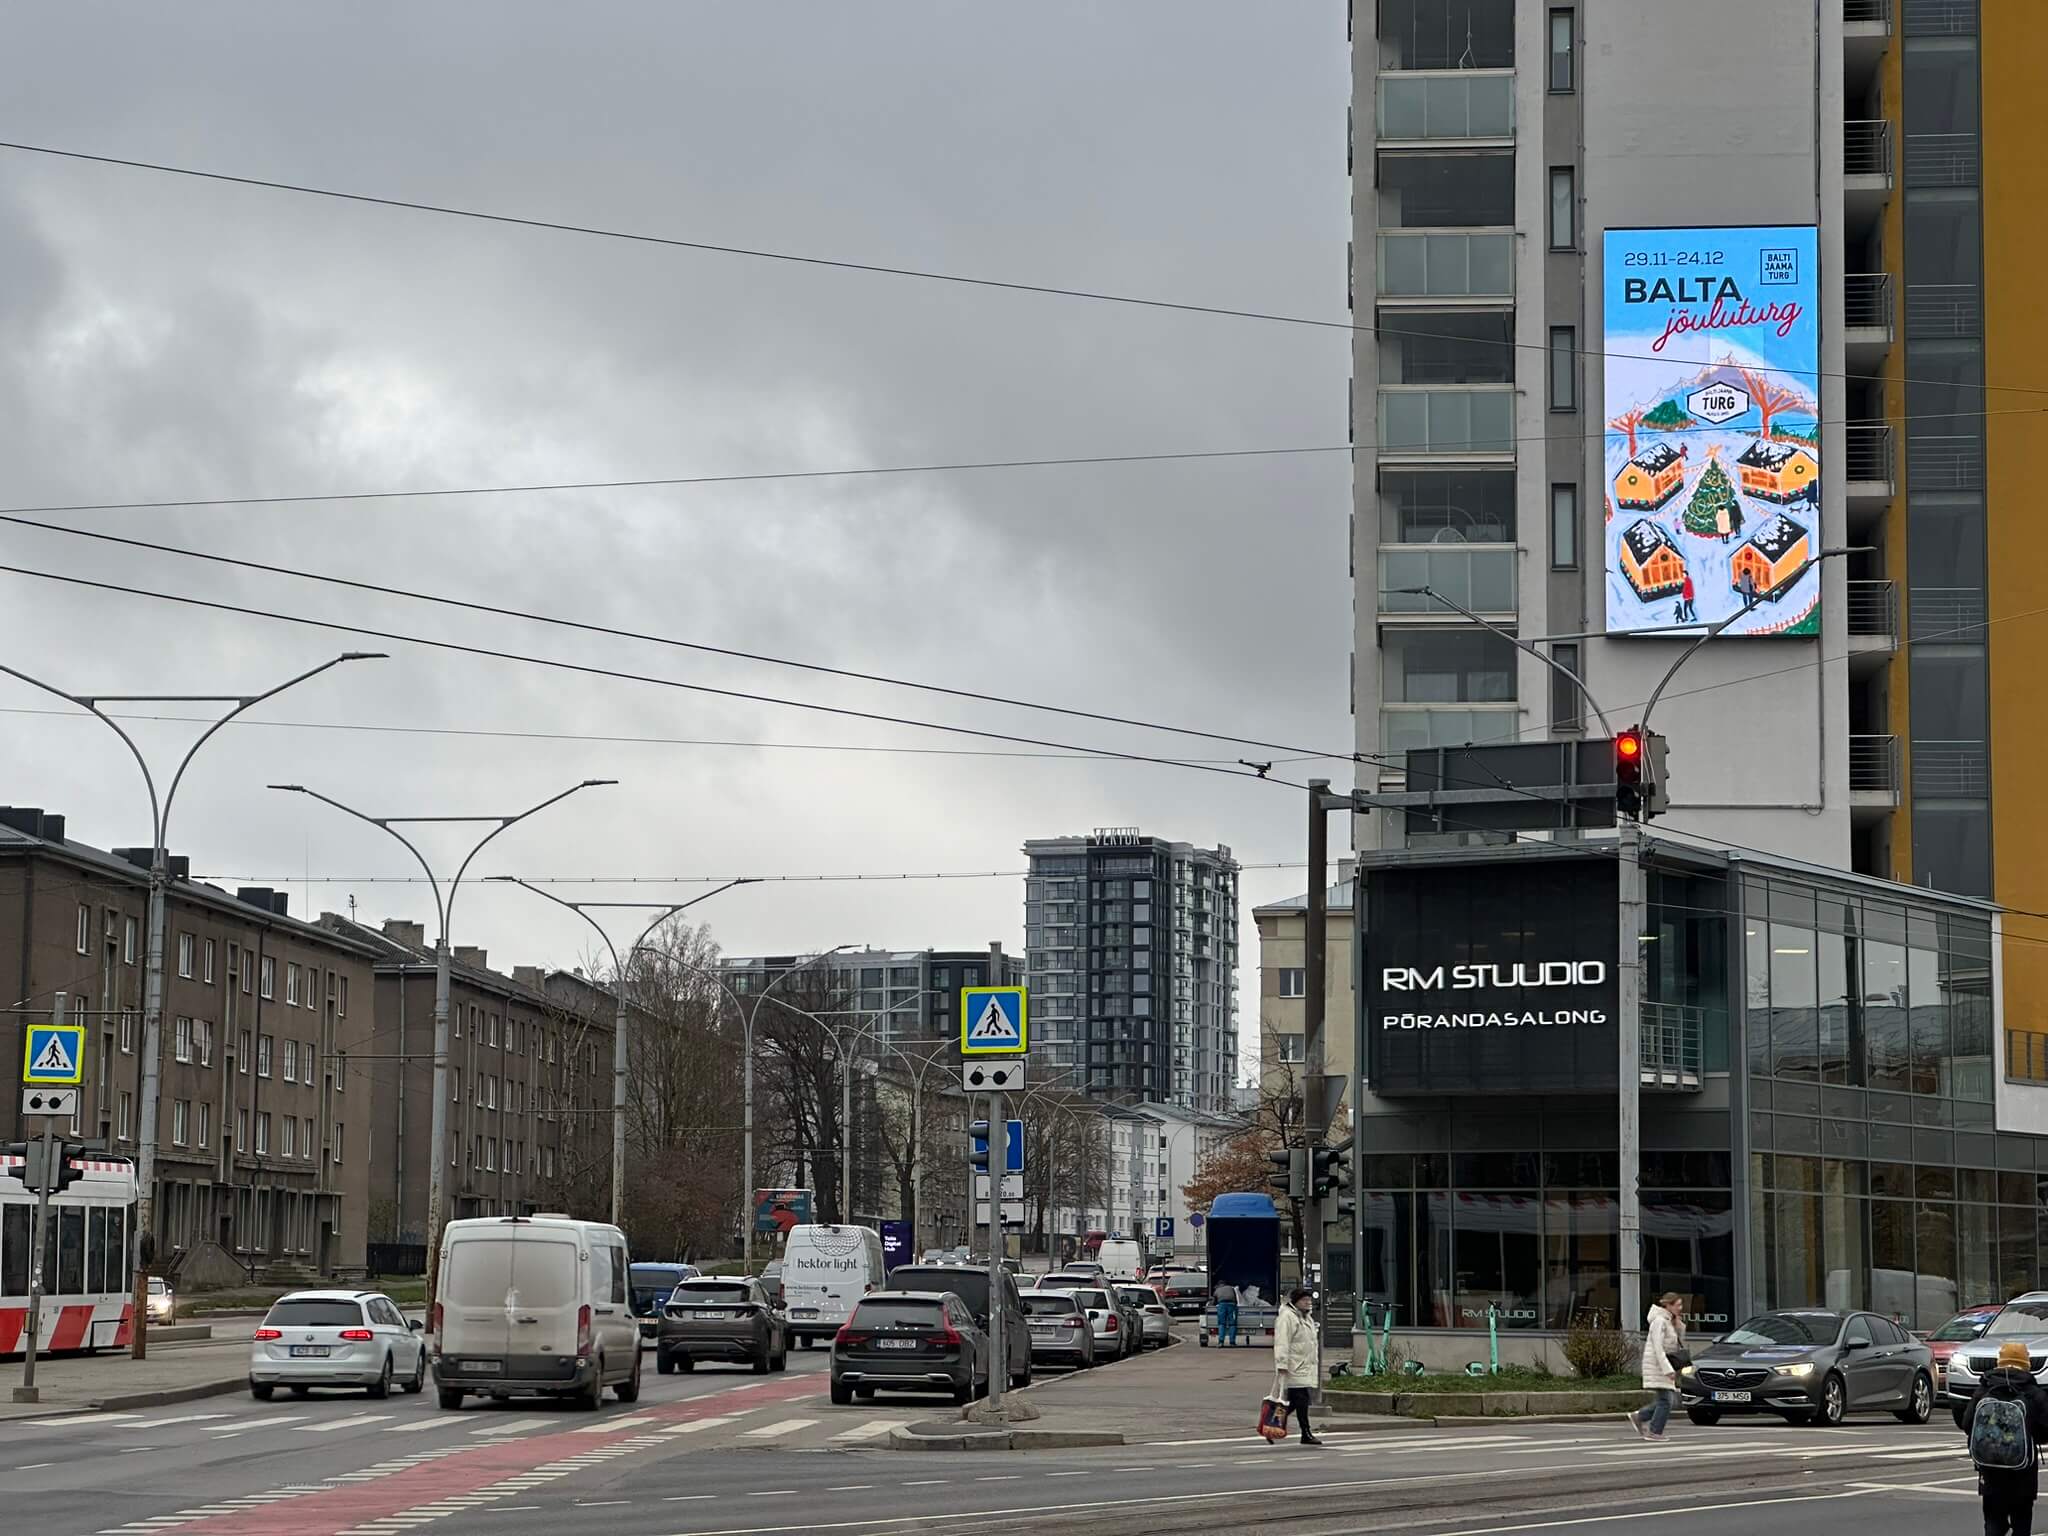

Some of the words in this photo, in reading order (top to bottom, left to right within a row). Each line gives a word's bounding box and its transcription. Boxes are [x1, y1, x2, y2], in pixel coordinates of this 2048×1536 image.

[1624, 250, 1724, 266] 29.11-24.12
[1767, 253, 1791, 262] BALTI
[1765, 262, 1793, 271] JAAMA
[1768, 271, 1790, 280] TURG
[1624, 276, 1743, 304] BALTA
[1652, 297, 1803, 353] jõuluturg
[1702, 396, 1735, 410] TURG
[1383, 966, 1446, 991] RM
[1452, 961, 1606, 989] STUUDIO
[1383, 1009, 1607, 1030] PÕRANDASALONG
[797, 1257, 833, 1269] hektor
[834, 1257, 857, 1272] light
[1462, 1308, 1483, 1319] RM
[1732, 1392, 1750, 1400] MSG
